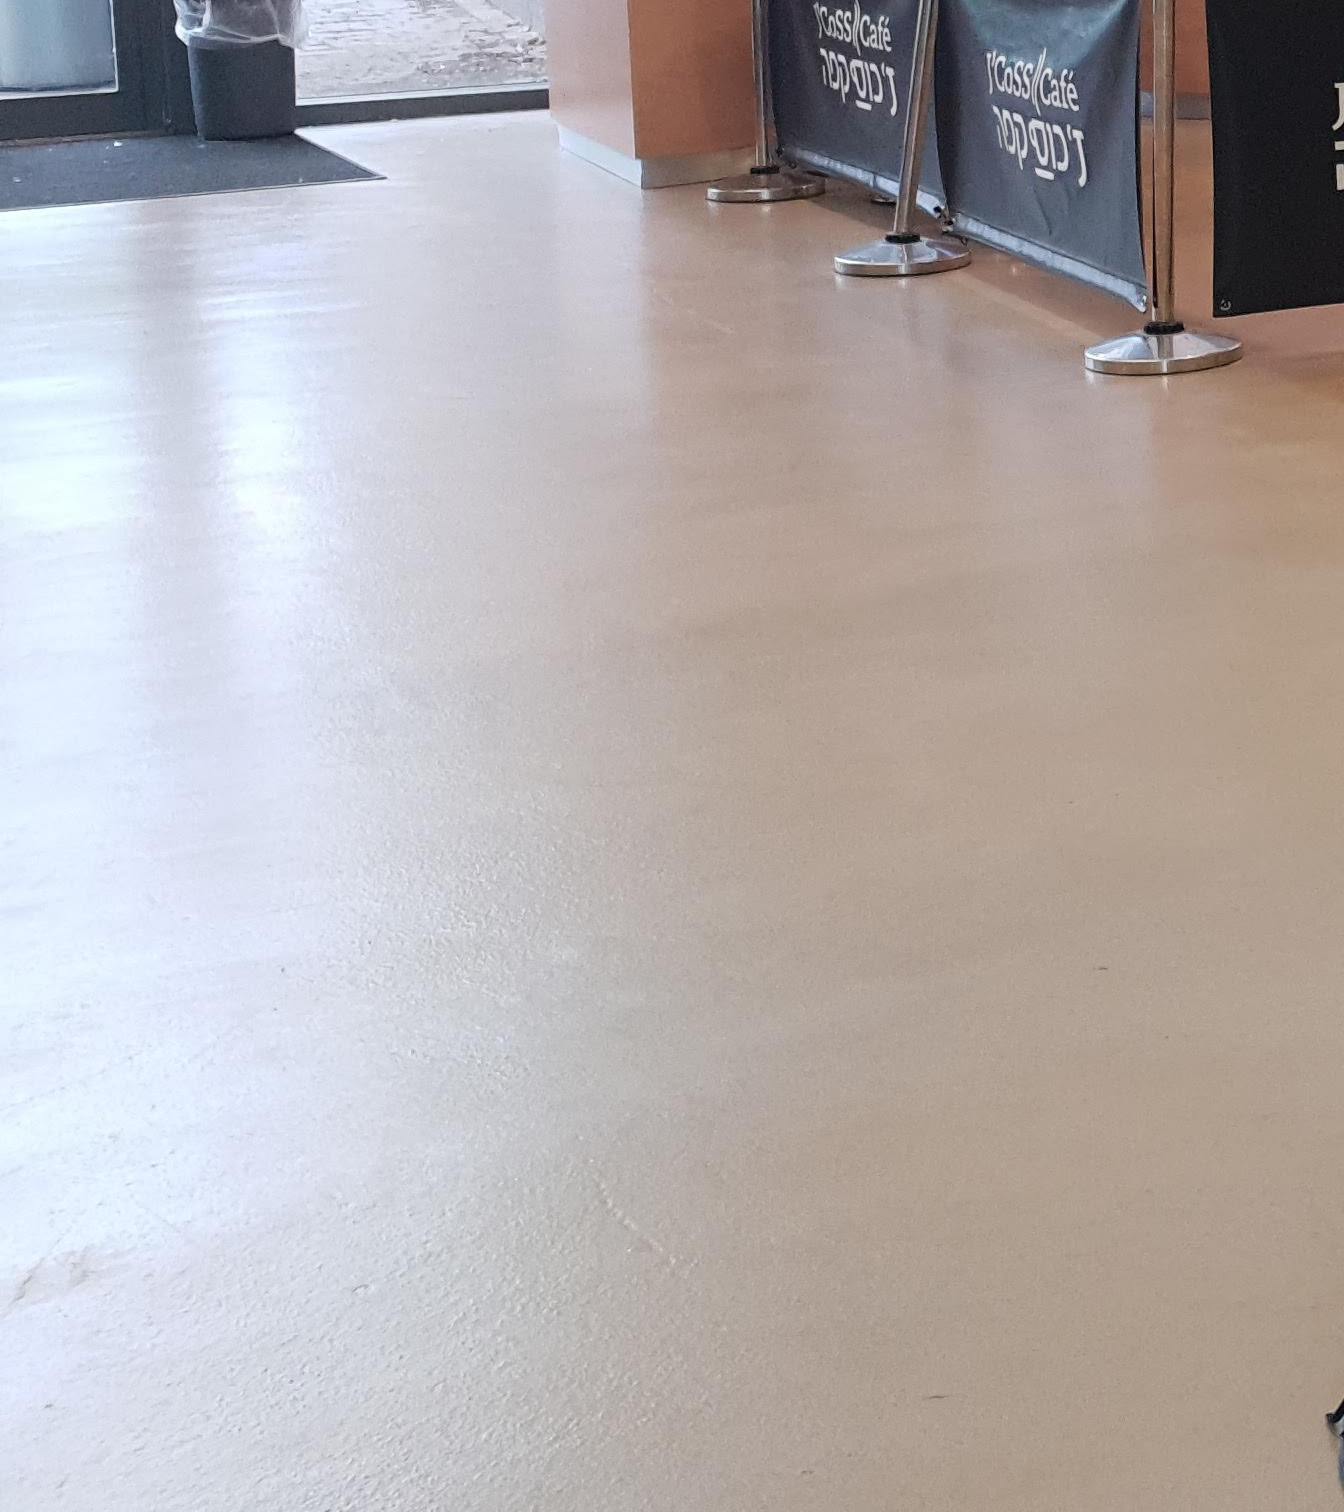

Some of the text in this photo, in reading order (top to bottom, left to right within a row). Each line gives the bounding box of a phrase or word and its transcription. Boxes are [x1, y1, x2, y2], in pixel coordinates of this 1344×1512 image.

[859, 14, 892, 53] Café
[819, 47, 850, 104] קפה
[1039, 67, 1080, 113] Café
[991, 104, 1028, 171] קפה
